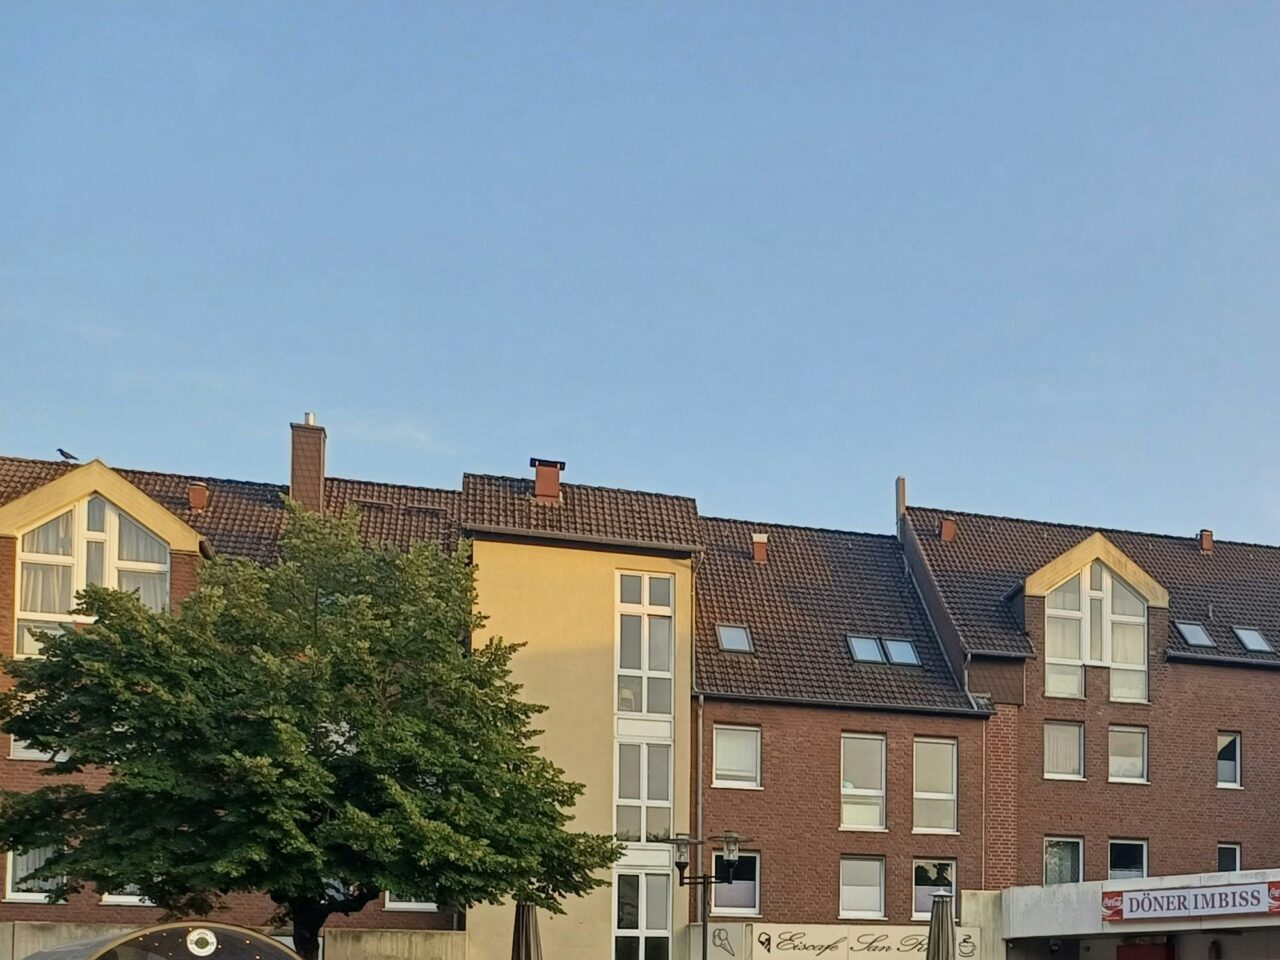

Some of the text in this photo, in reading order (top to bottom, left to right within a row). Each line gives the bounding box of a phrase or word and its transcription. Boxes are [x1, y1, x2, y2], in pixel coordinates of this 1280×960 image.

[1128, 889, 1261, 913] DÖNER IMBISS
[850, 933, 892, 953] San
